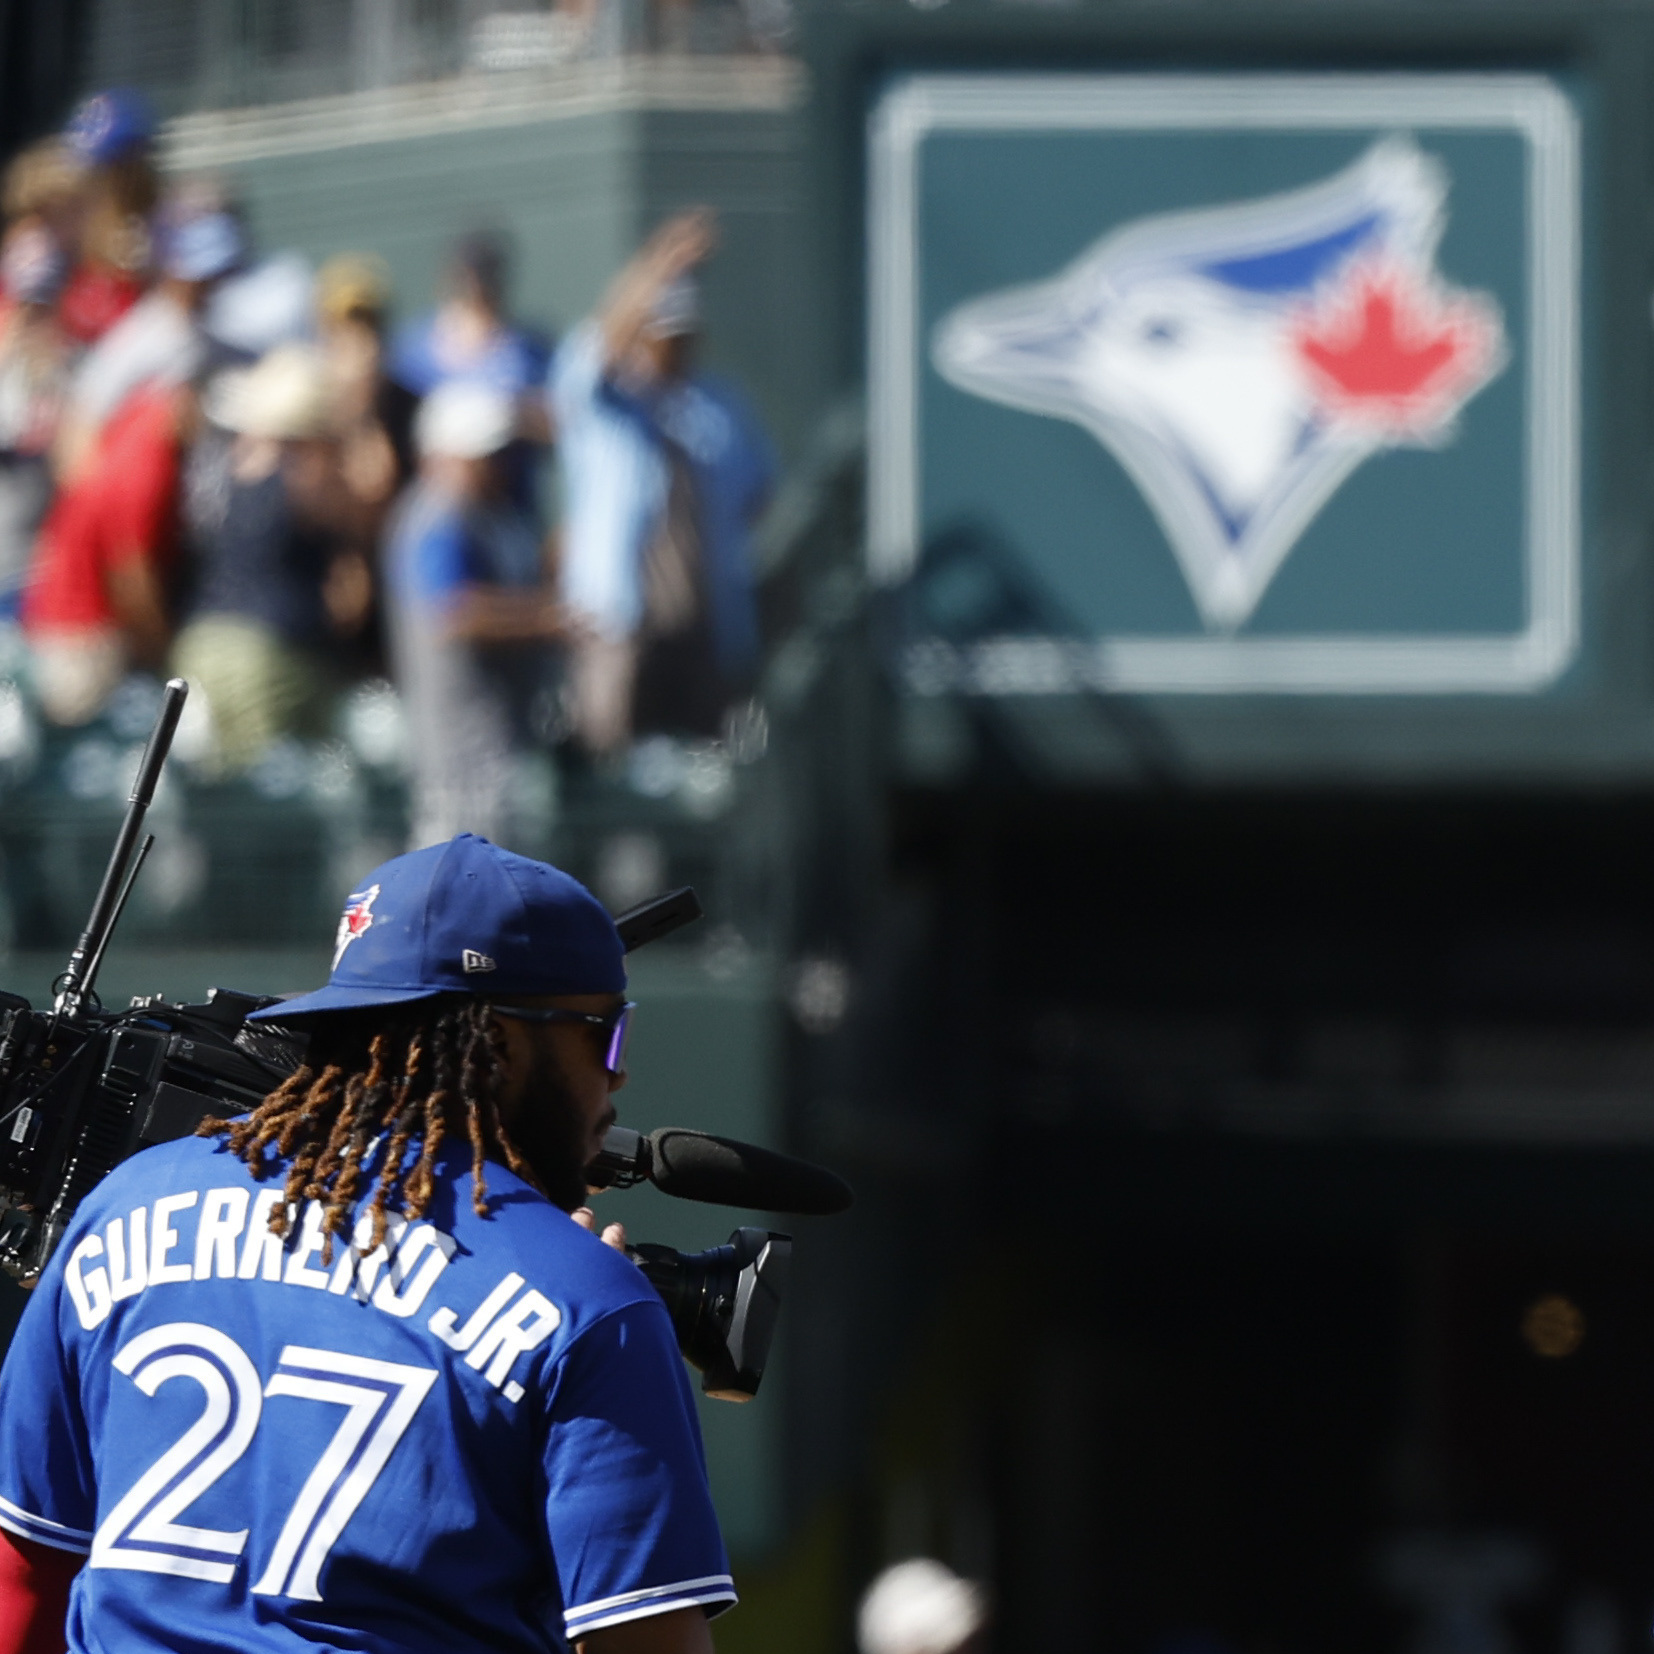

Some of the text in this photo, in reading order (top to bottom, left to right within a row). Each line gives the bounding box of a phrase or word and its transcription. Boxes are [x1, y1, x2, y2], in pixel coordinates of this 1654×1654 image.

[65, 1187, 562, 1404] GUERRERO JR.
[89, 1322, 440, 1603] 27
